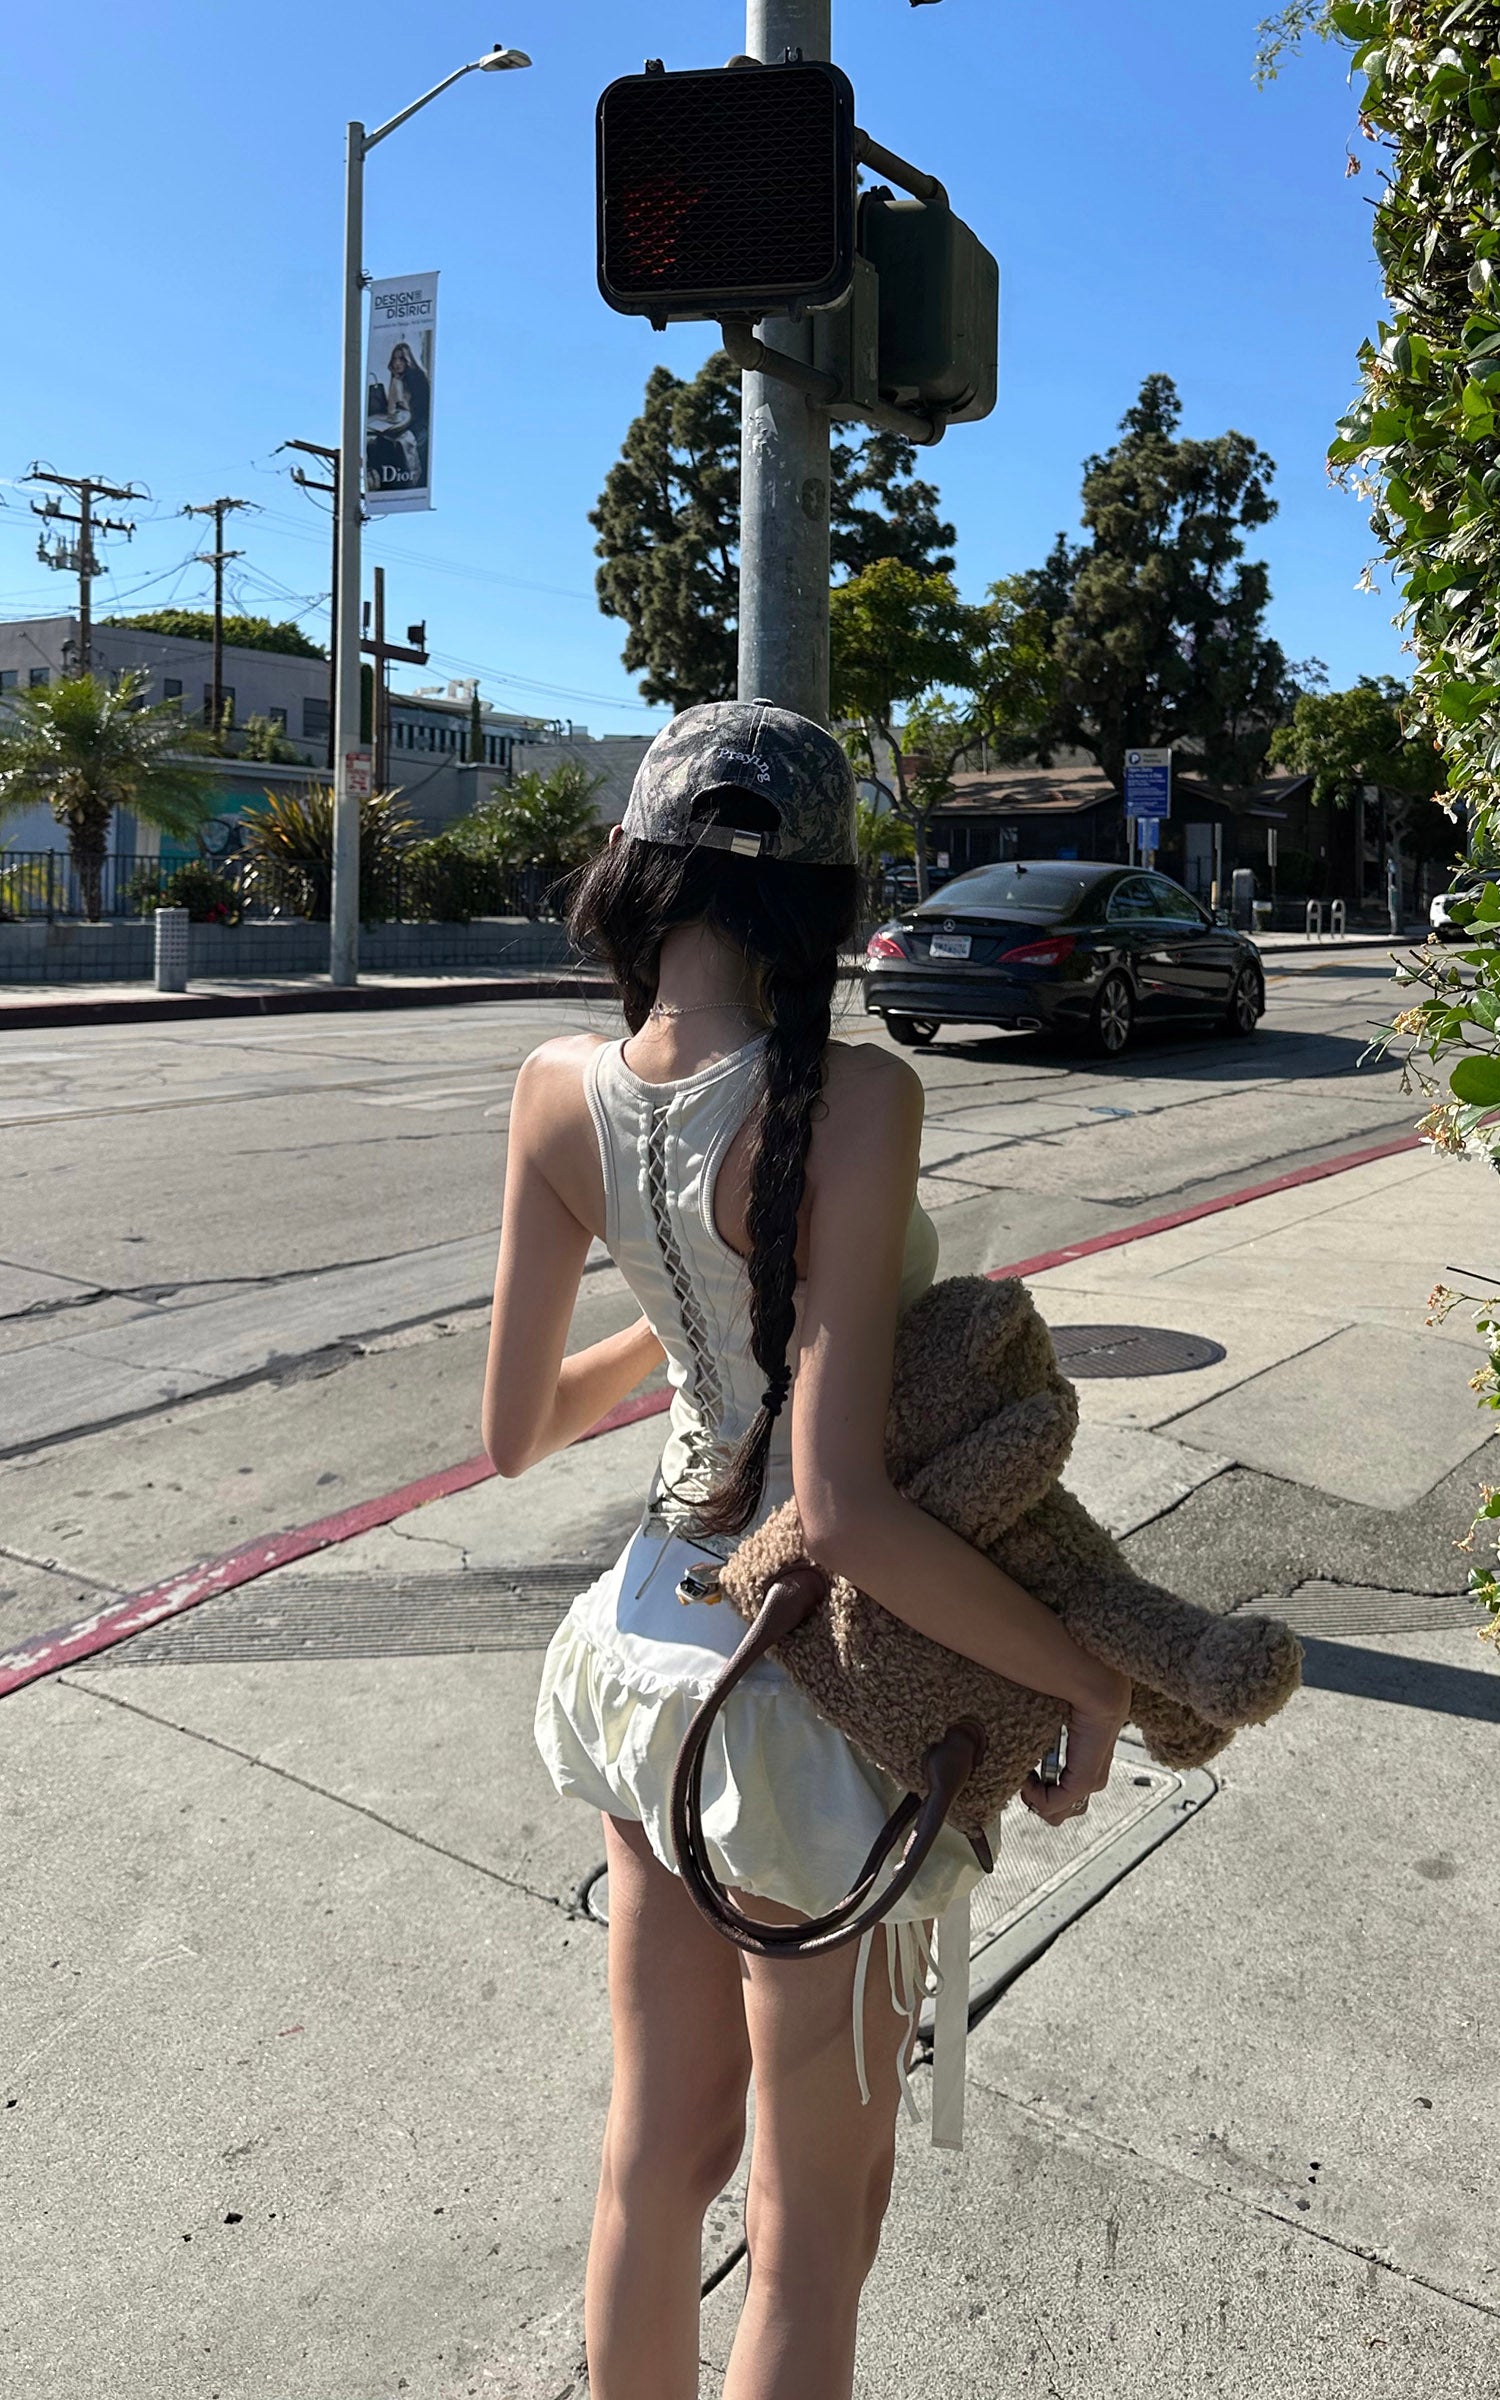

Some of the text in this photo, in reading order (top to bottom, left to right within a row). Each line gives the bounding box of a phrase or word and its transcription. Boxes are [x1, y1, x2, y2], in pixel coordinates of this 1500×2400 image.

[375, 291, 414, 307] DESIGN
[387, 301, 432, 319] DISTRICT
[382, 464, 416, 483] Dior
[718, 747, 770, 783] Praying
